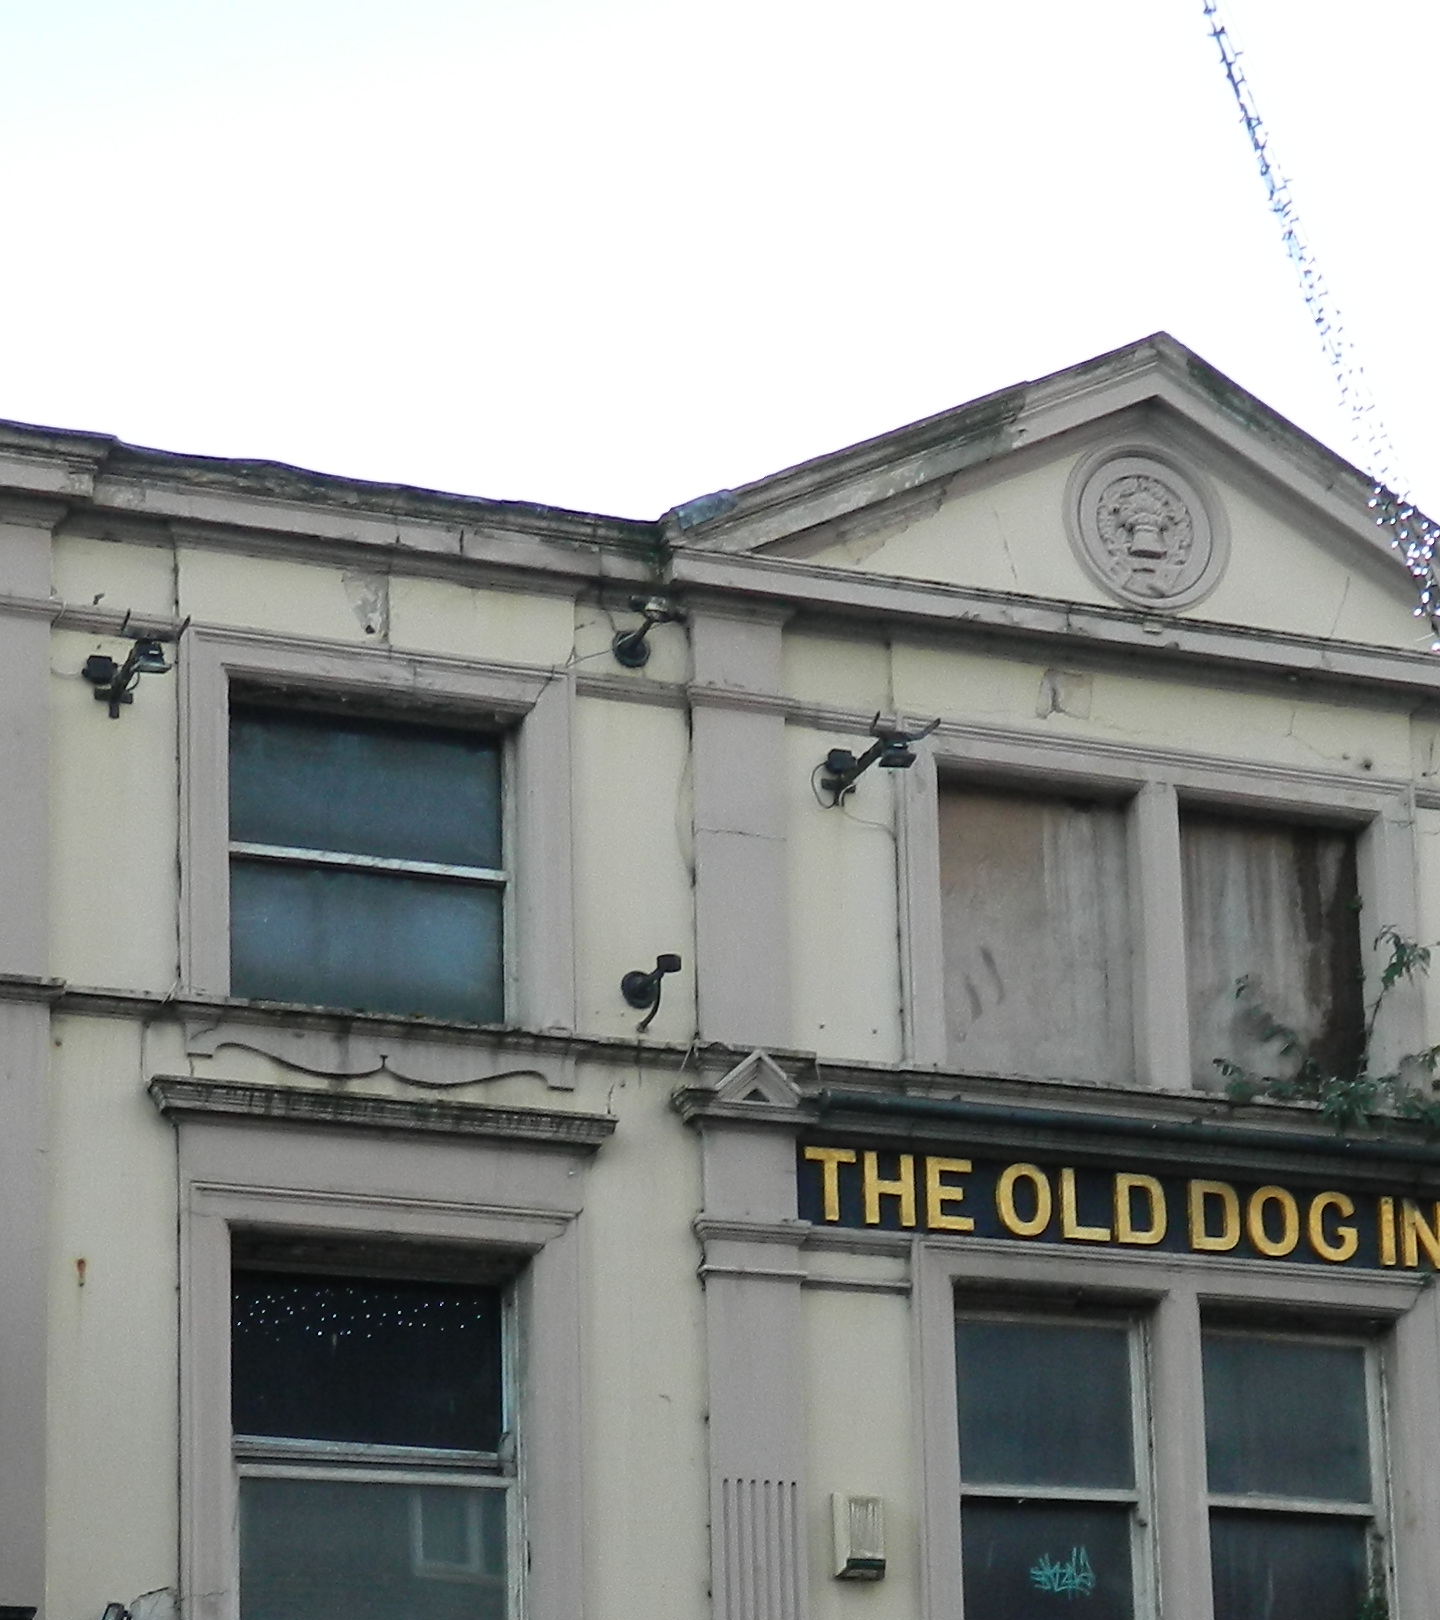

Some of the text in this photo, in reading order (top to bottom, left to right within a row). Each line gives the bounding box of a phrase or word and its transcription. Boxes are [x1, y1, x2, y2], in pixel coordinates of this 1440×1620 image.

[805, 1147, 975, 1232] THE
[995, 1162, 1168, 1245] OLD
[1187, 1179, 1359, 1262] DOG
